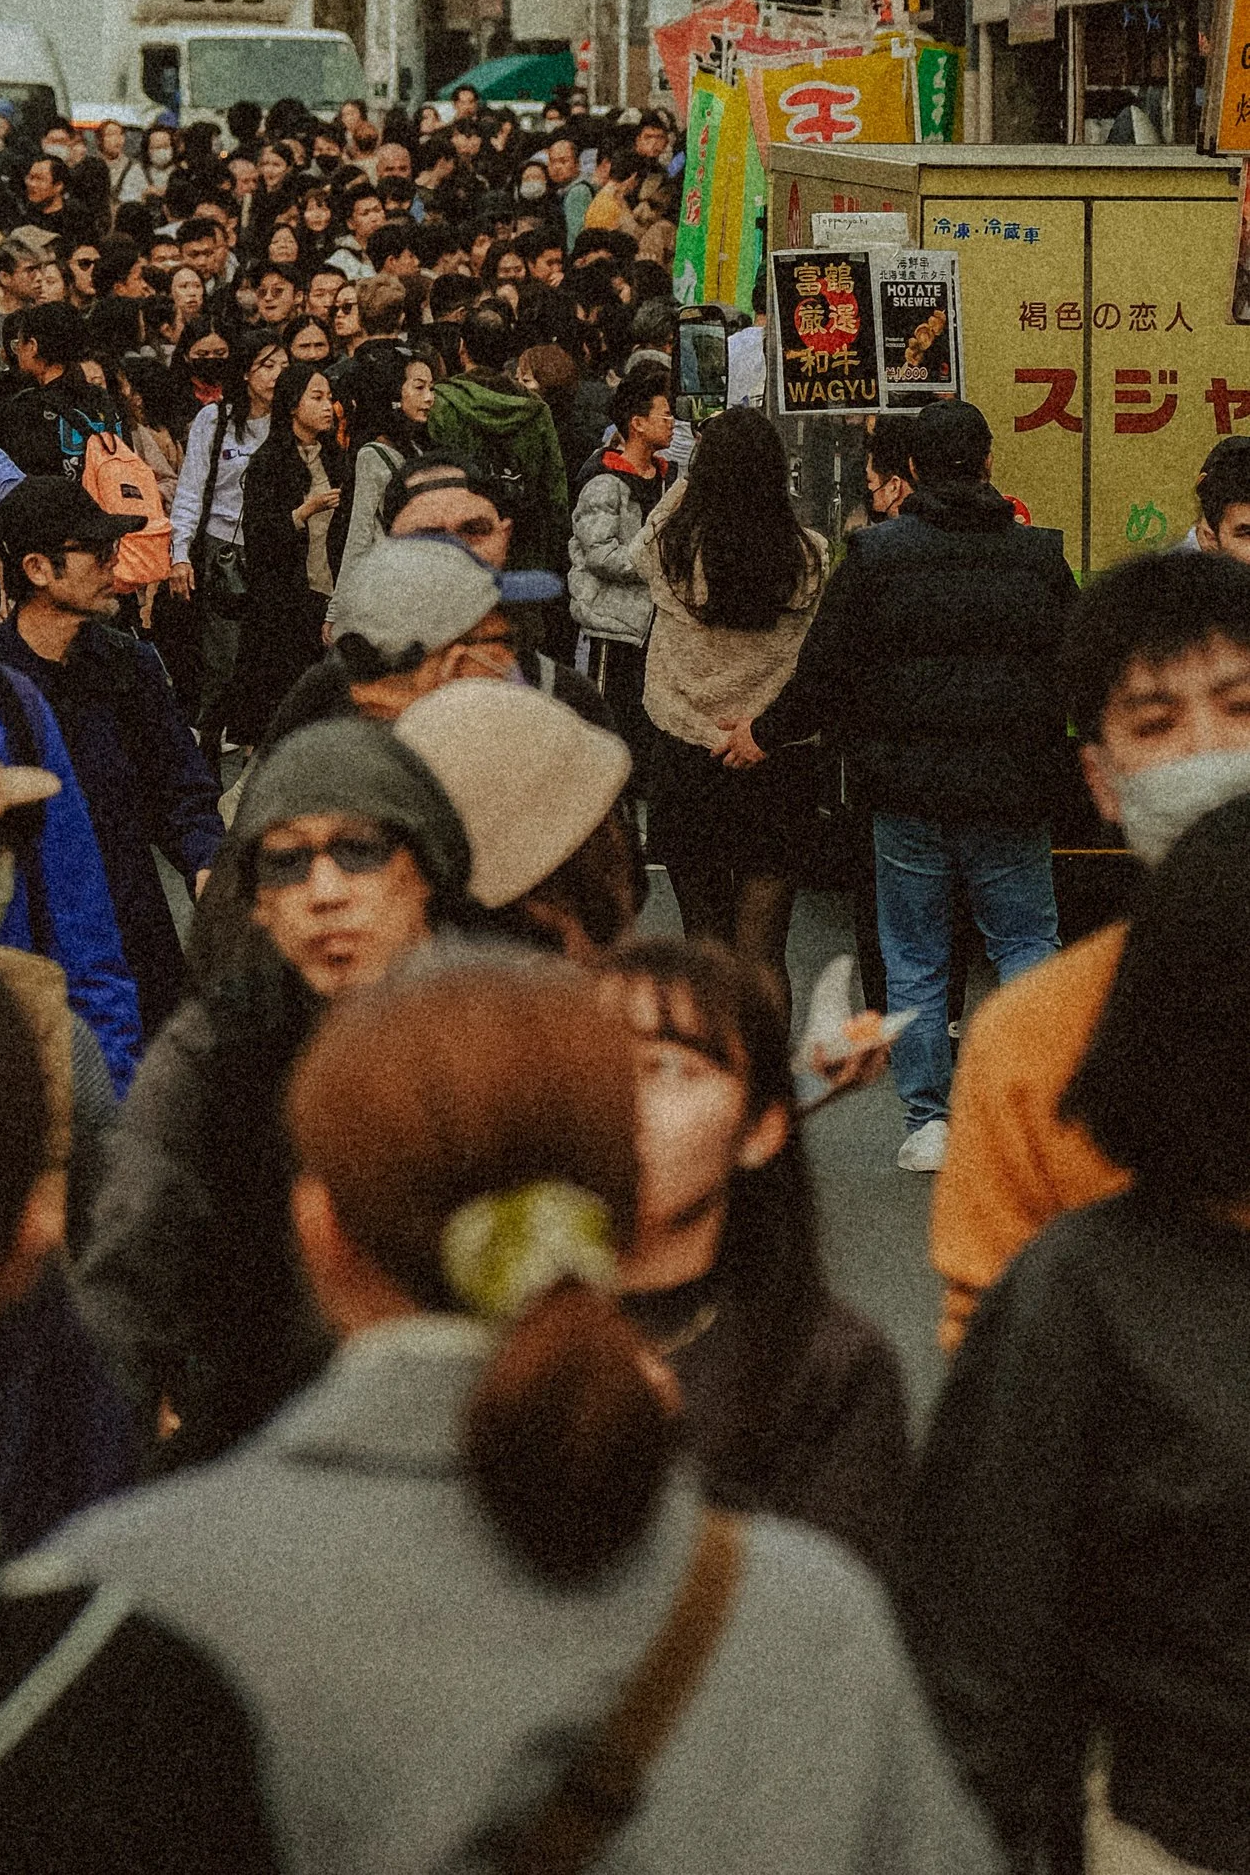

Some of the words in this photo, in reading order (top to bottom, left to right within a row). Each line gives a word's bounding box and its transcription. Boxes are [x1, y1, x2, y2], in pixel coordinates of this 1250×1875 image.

[793, 261, 855, 296] 富鶴
[887, 284, 942, 297] HOTATE
[892, 297, 937, 307] SKEWER
[1018, 301, 1194, 333] 褐色の恋人
[797, 303, 859, 337] 厳選
[799, 343, 861, 377] 和牛
[885, 366, 928, 382] ¥1,000
[787, 378, 877, 404] WAGYU
[1125, 500, 1168, 543] め
